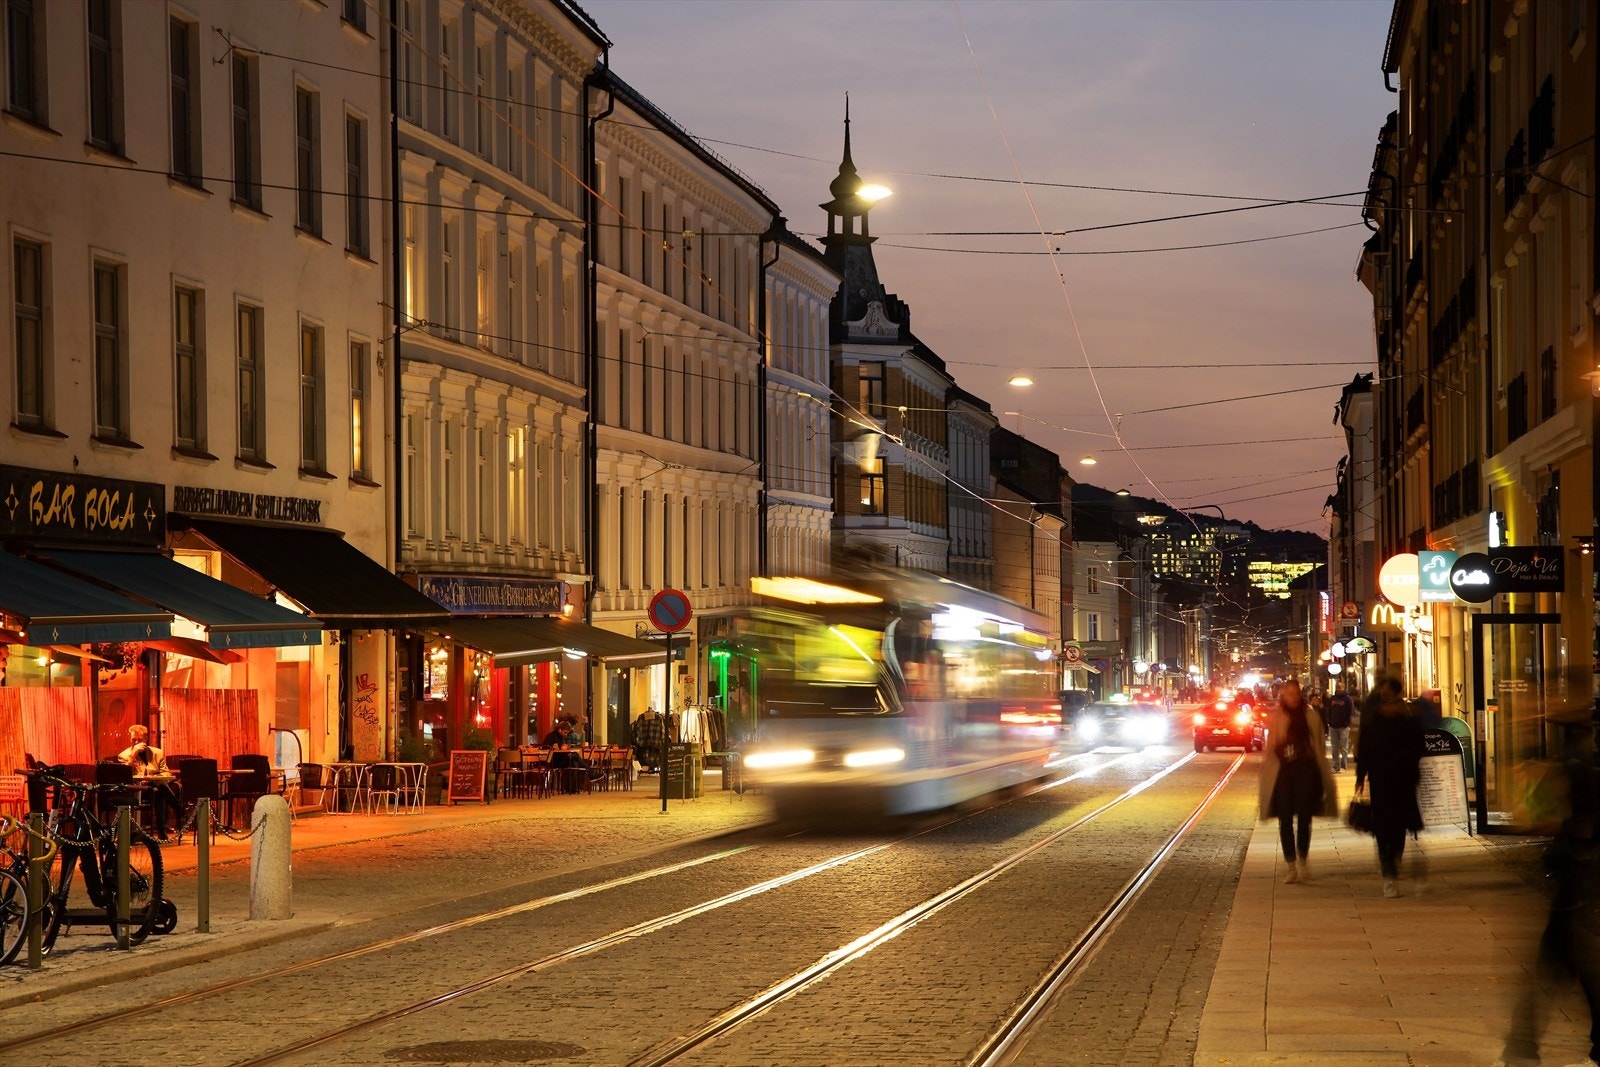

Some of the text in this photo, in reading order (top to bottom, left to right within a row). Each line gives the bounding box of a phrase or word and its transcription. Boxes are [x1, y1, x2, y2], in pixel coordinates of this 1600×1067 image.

[30, 480, 135, 531] BAR BOCA
[174, 486, 321, 523] BIRKELUNDEN SPILLEKIOSK
[1383, 574, 1418, 586] EXTR
